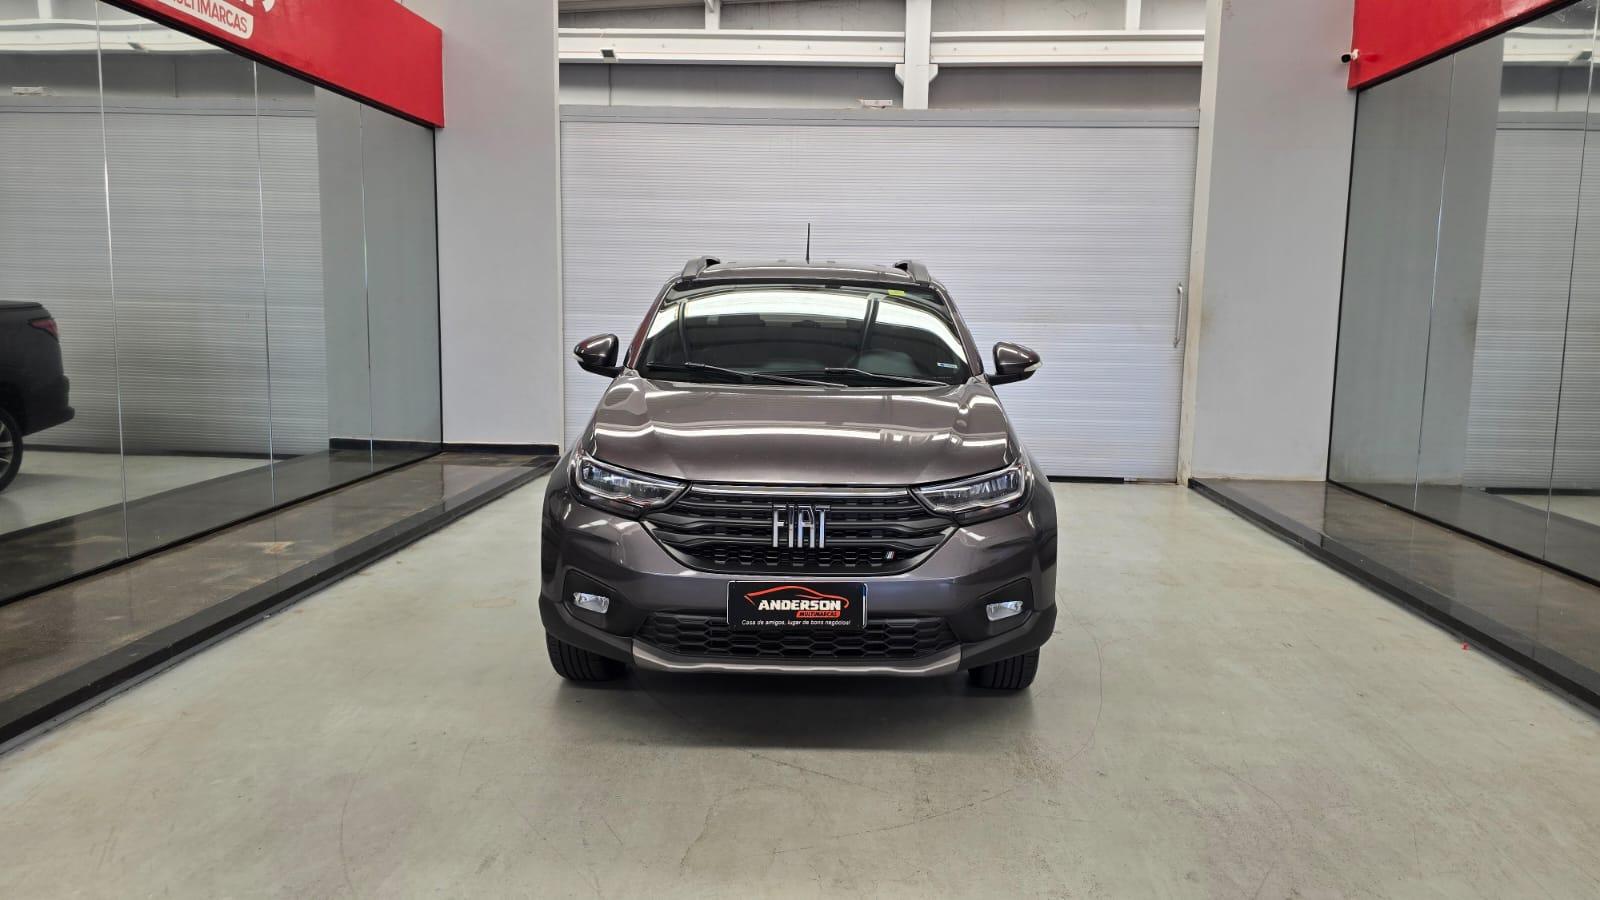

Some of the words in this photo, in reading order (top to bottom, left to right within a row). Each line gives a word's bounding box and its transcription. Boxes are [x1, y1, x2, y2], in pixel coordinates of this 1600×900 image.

[174, 0, 248, 33] LTIMARCAS
[772, 503, 831, 549] FIAT
[758, 599, 841, 611] ANDERSON
[787, 619, 801, 627] lugar
